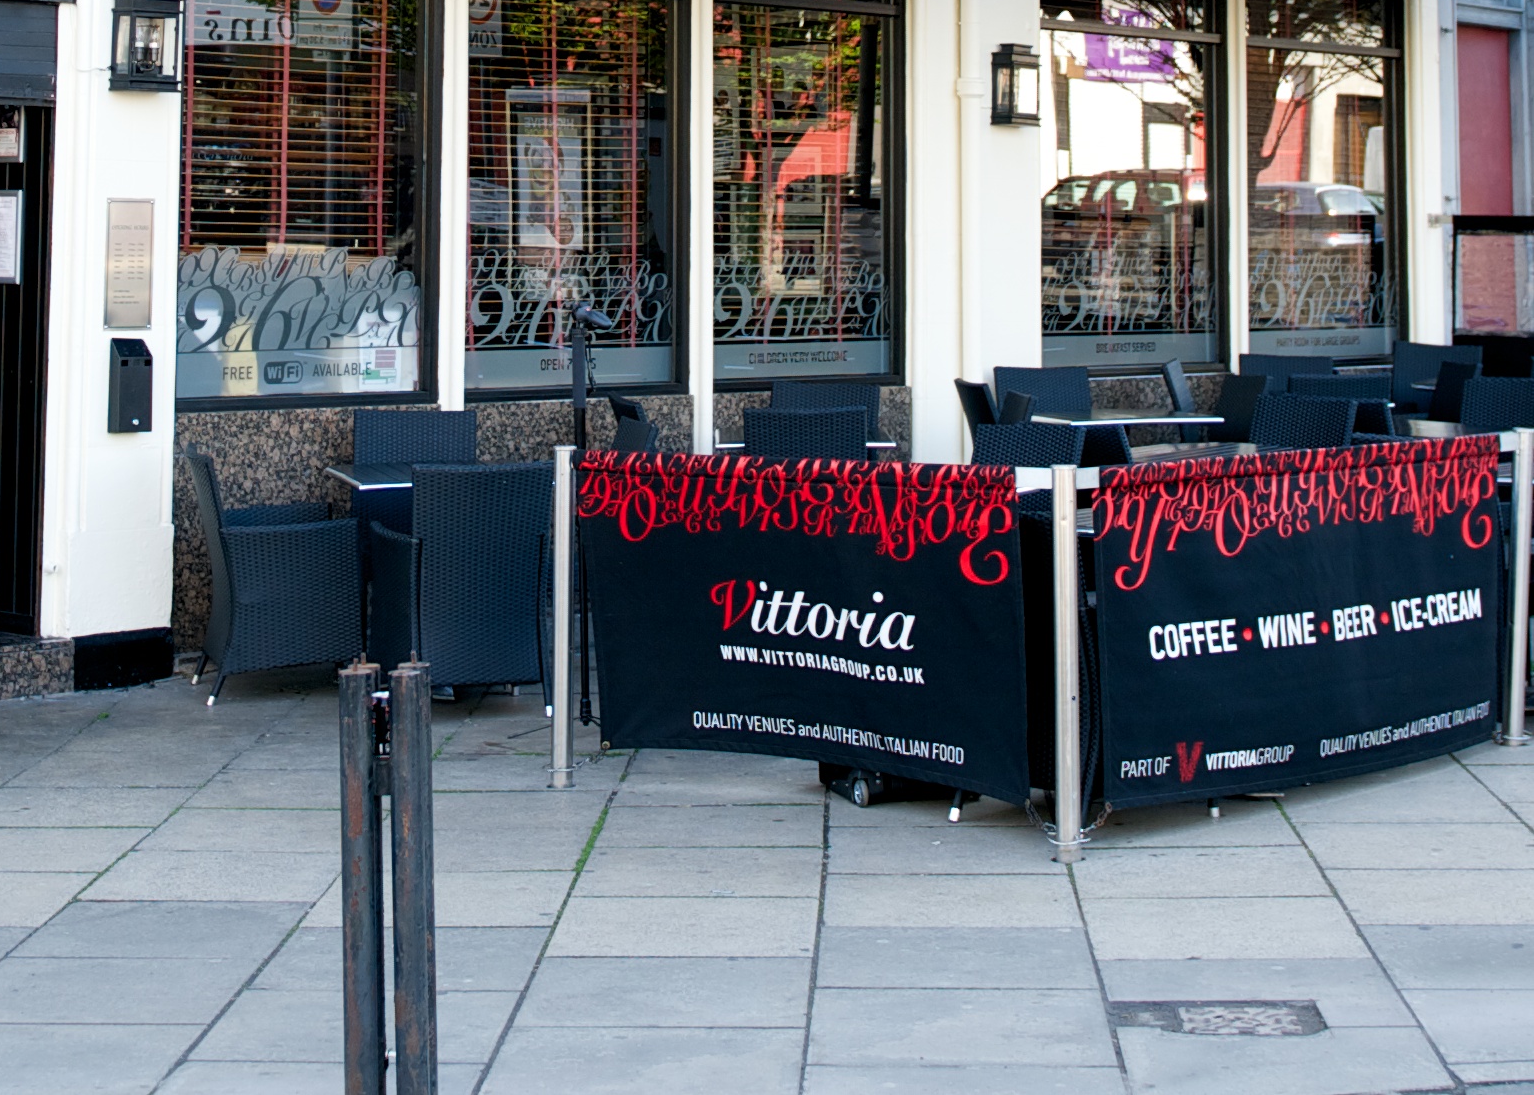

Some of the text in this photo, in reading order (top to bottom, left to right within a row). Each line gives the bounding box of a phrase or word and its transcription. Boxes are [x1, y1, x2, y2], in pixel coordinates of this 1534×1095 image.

[540, 358, 565, 371] OPEN
[1096, 342, 1156, 353] BREAKFAST SERVED
[223, 365, 254, 380] FREE
[312, 361, 372, 376] AVAILABLE
[710, 579, 915, 651] Vittoria
[1148, 588, 1482, 660] COFFEE WINE BEER ICE-CREAM
[720, 645, 925, 684] WWW.VITTORIAGROUP.CO.UK
[693, 711, 964, 764] QUALITY VENUES and AUTHENTIC ITALIAN FOOD
[1320, 735, 1358, 758] QUALITY
[1358, 726, 1392, 749] VENUES
[1392, 722, 1409, 741] and
[1409, 711, 1452, 738] AUTHENTIC
[1120, 758, 1152, 779] PART
[1154, 756, 1172, 775] OF
[1205, 744, 1295, 771] VITTORIAGROUP
